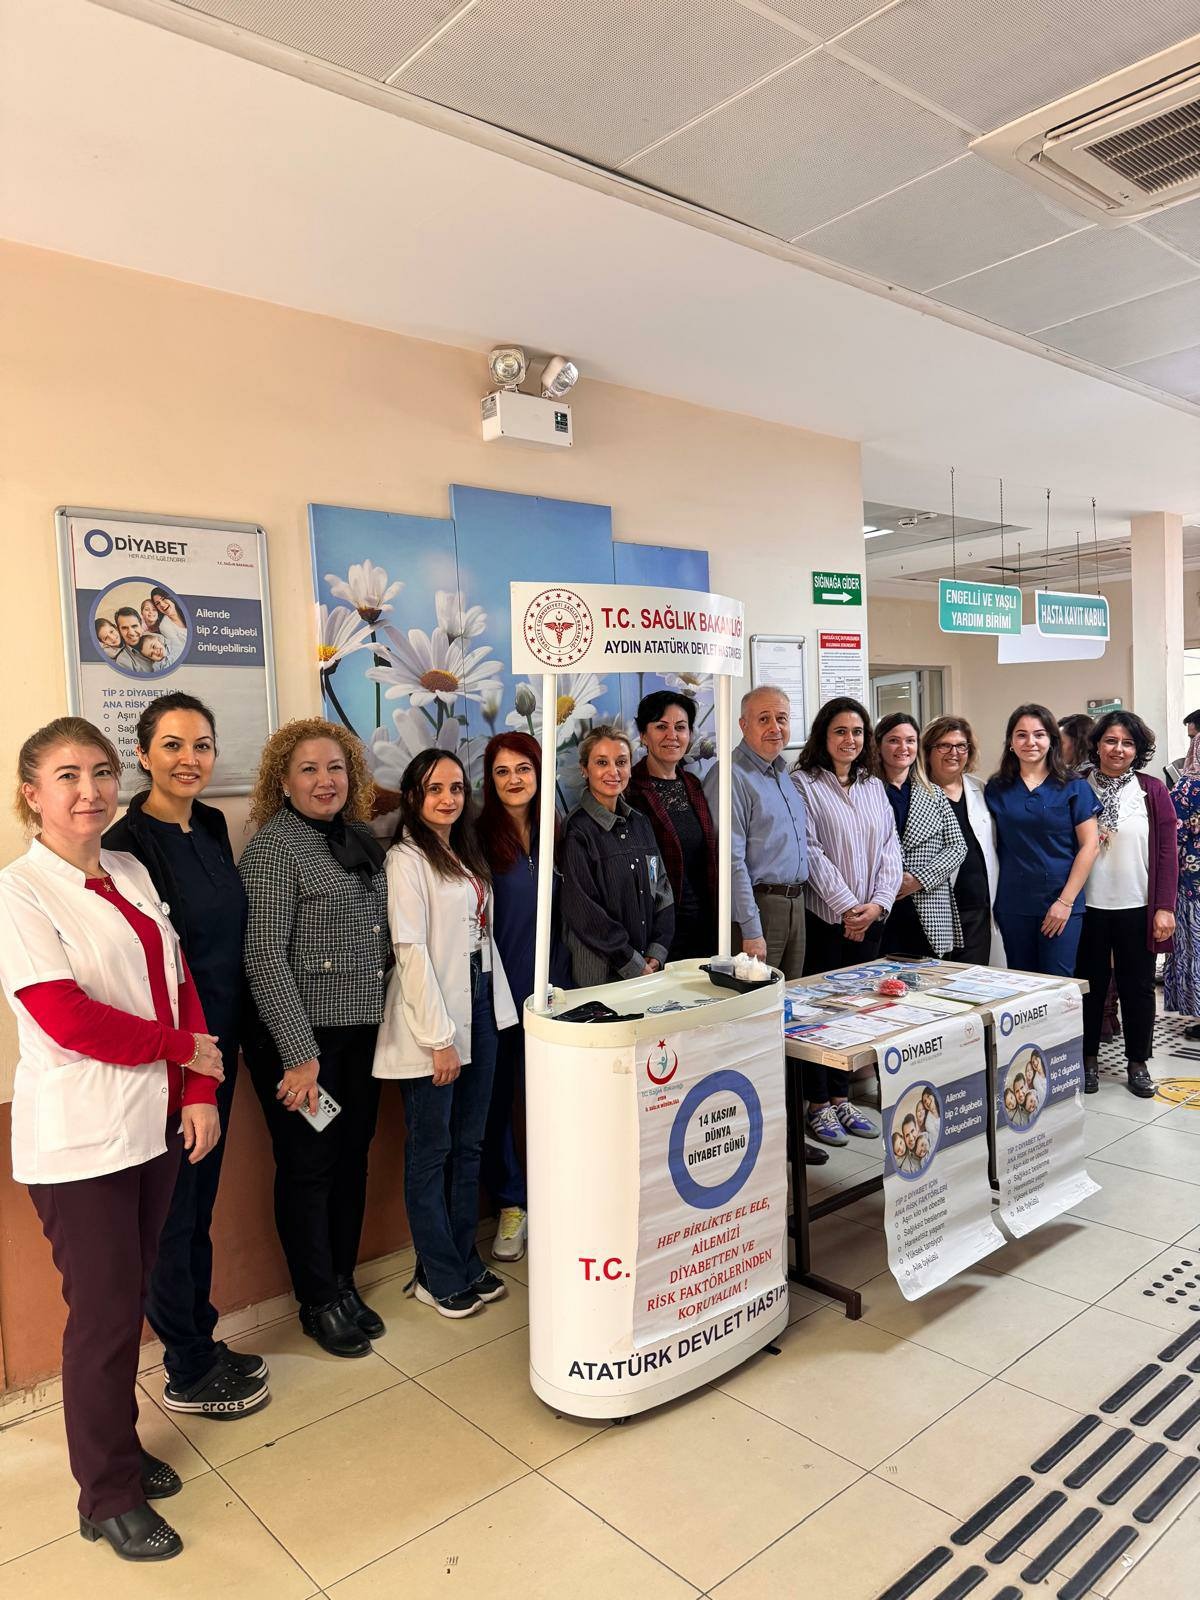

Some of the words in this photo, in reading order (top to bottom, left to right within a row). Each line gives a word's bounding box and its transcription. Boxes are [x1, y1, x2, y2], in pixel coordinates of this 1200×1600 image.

[114, 535, 188, 556] DİYABET
[814, 574, 841, 589] SIĞINAĞA
[842, 575, 860, 590] GİDER
[946, 589, 980, 606] ENGELLİ
[982, 593, 993, 606] VE
[995, 594, 1016, 610] YAŞLI
[196, 608, 230, 619] Ailende
[601, 608, 636, 629] T.C.
[640, 604, 697, 631] SAĞLIK
[699, 612, 743, 637] BAKANLIĞI
[952, 612, 983, 627] YARDIM
[986, 612, 1011, 629] BİRİMİ
[1041, 604, 1063, 624] HASTA
[1065, 606, 1083, 626] KAYIT
[1084, 607, 1106, 627] KABUL
[196, 625, 211, 637] tip
[212, 626, 219, 635] 2
[220, 627, 258, 638] diyabeti
[197, 641, 257, 654] önleyebilirsin
[604, 640, 641, 654] AYDIN
[644, 637, 690, 655] ATATÜRK
[691, 642, 717, 656] DEVLET
[102, 688, 117, 697] TİP
[127, 688, 164, 697] DİYABET
[125, 699, 146, 708] RİSK
[117, 712, 137, 721] Aşırı
[1014, 1004, 1048, 1026] DİYABET
[902, 1036, 943, 1062] DİYABET
[945, 1089, 967, 1104] Ailende
[699, 1114, 709, 1127] 14
[711, 1106, 736, 1123] KASIM
[945, 1110, 954, 1120] tip
[954, 1106, 959, 1116] 2
[705, 1125, 731, 1143] DÜNYA
[688, 1144, 722, 1166] DİYABET
[724, 1134, 746, 1153] GÜNÜ
[657, 1230, 680, 1248] HEP
[683, 1211, 733, 1240] BİRLİKTE
[735, 1206, 747, 1219] EL
[750, 1197, 770, 1214] ELE,
[692, 1224, 741, 1255] AİLEMİZİ
[578, 1257, 631, 1281] T.C.
[670, 1246, 739, 1284] DİYABETTEN
[742, 1240, 755, 1254] VE
[647, 1291, 676, 1312] RİSK
[680, 1249, 772, 1301] FAKTÖRLERİNDEN
[677, 1280, 741, 1320] KORUYALIM
[744, 1279, 748, 1290] !
[568, 1345, 673, 1380] ATATÜRK
[678, 1310, 743, 1358] DEVLET
[202, 1401, 245, 1411] crocs
